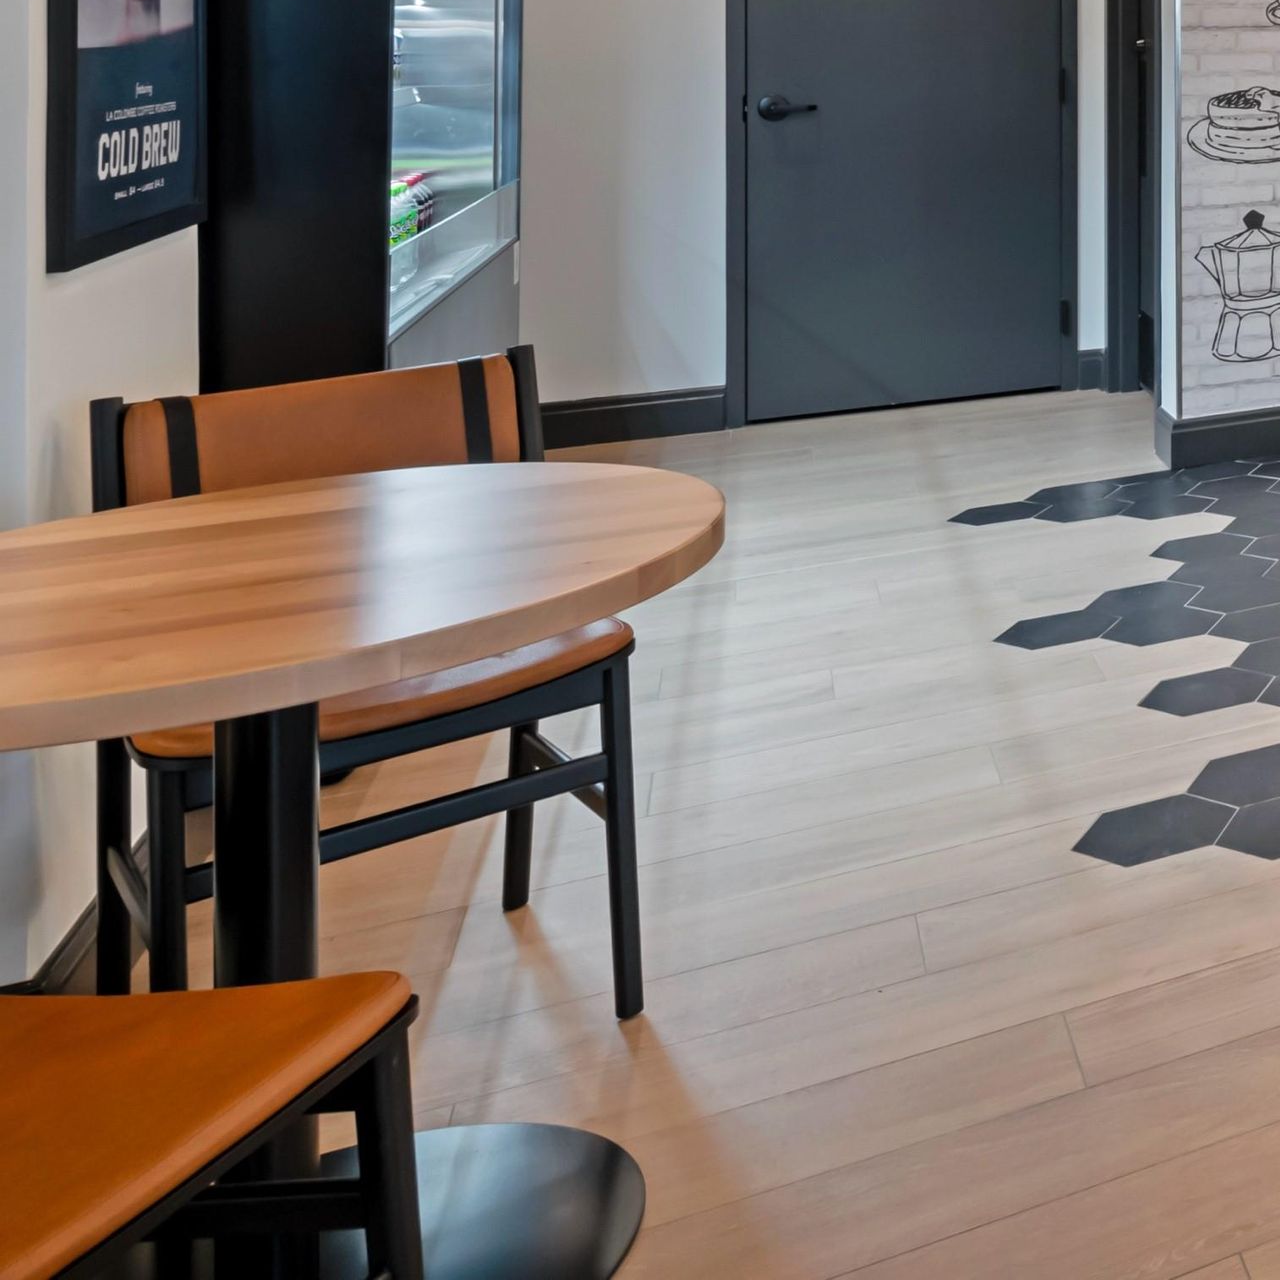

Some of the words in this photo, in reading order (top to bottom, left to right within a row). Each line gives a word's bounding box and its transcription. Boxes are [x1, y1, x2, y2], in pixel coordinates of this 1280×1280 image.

[106, 111, 114, 122] LA
[97, 127, 139, 181] COLD
[141, 119, 181, 171] BREW
